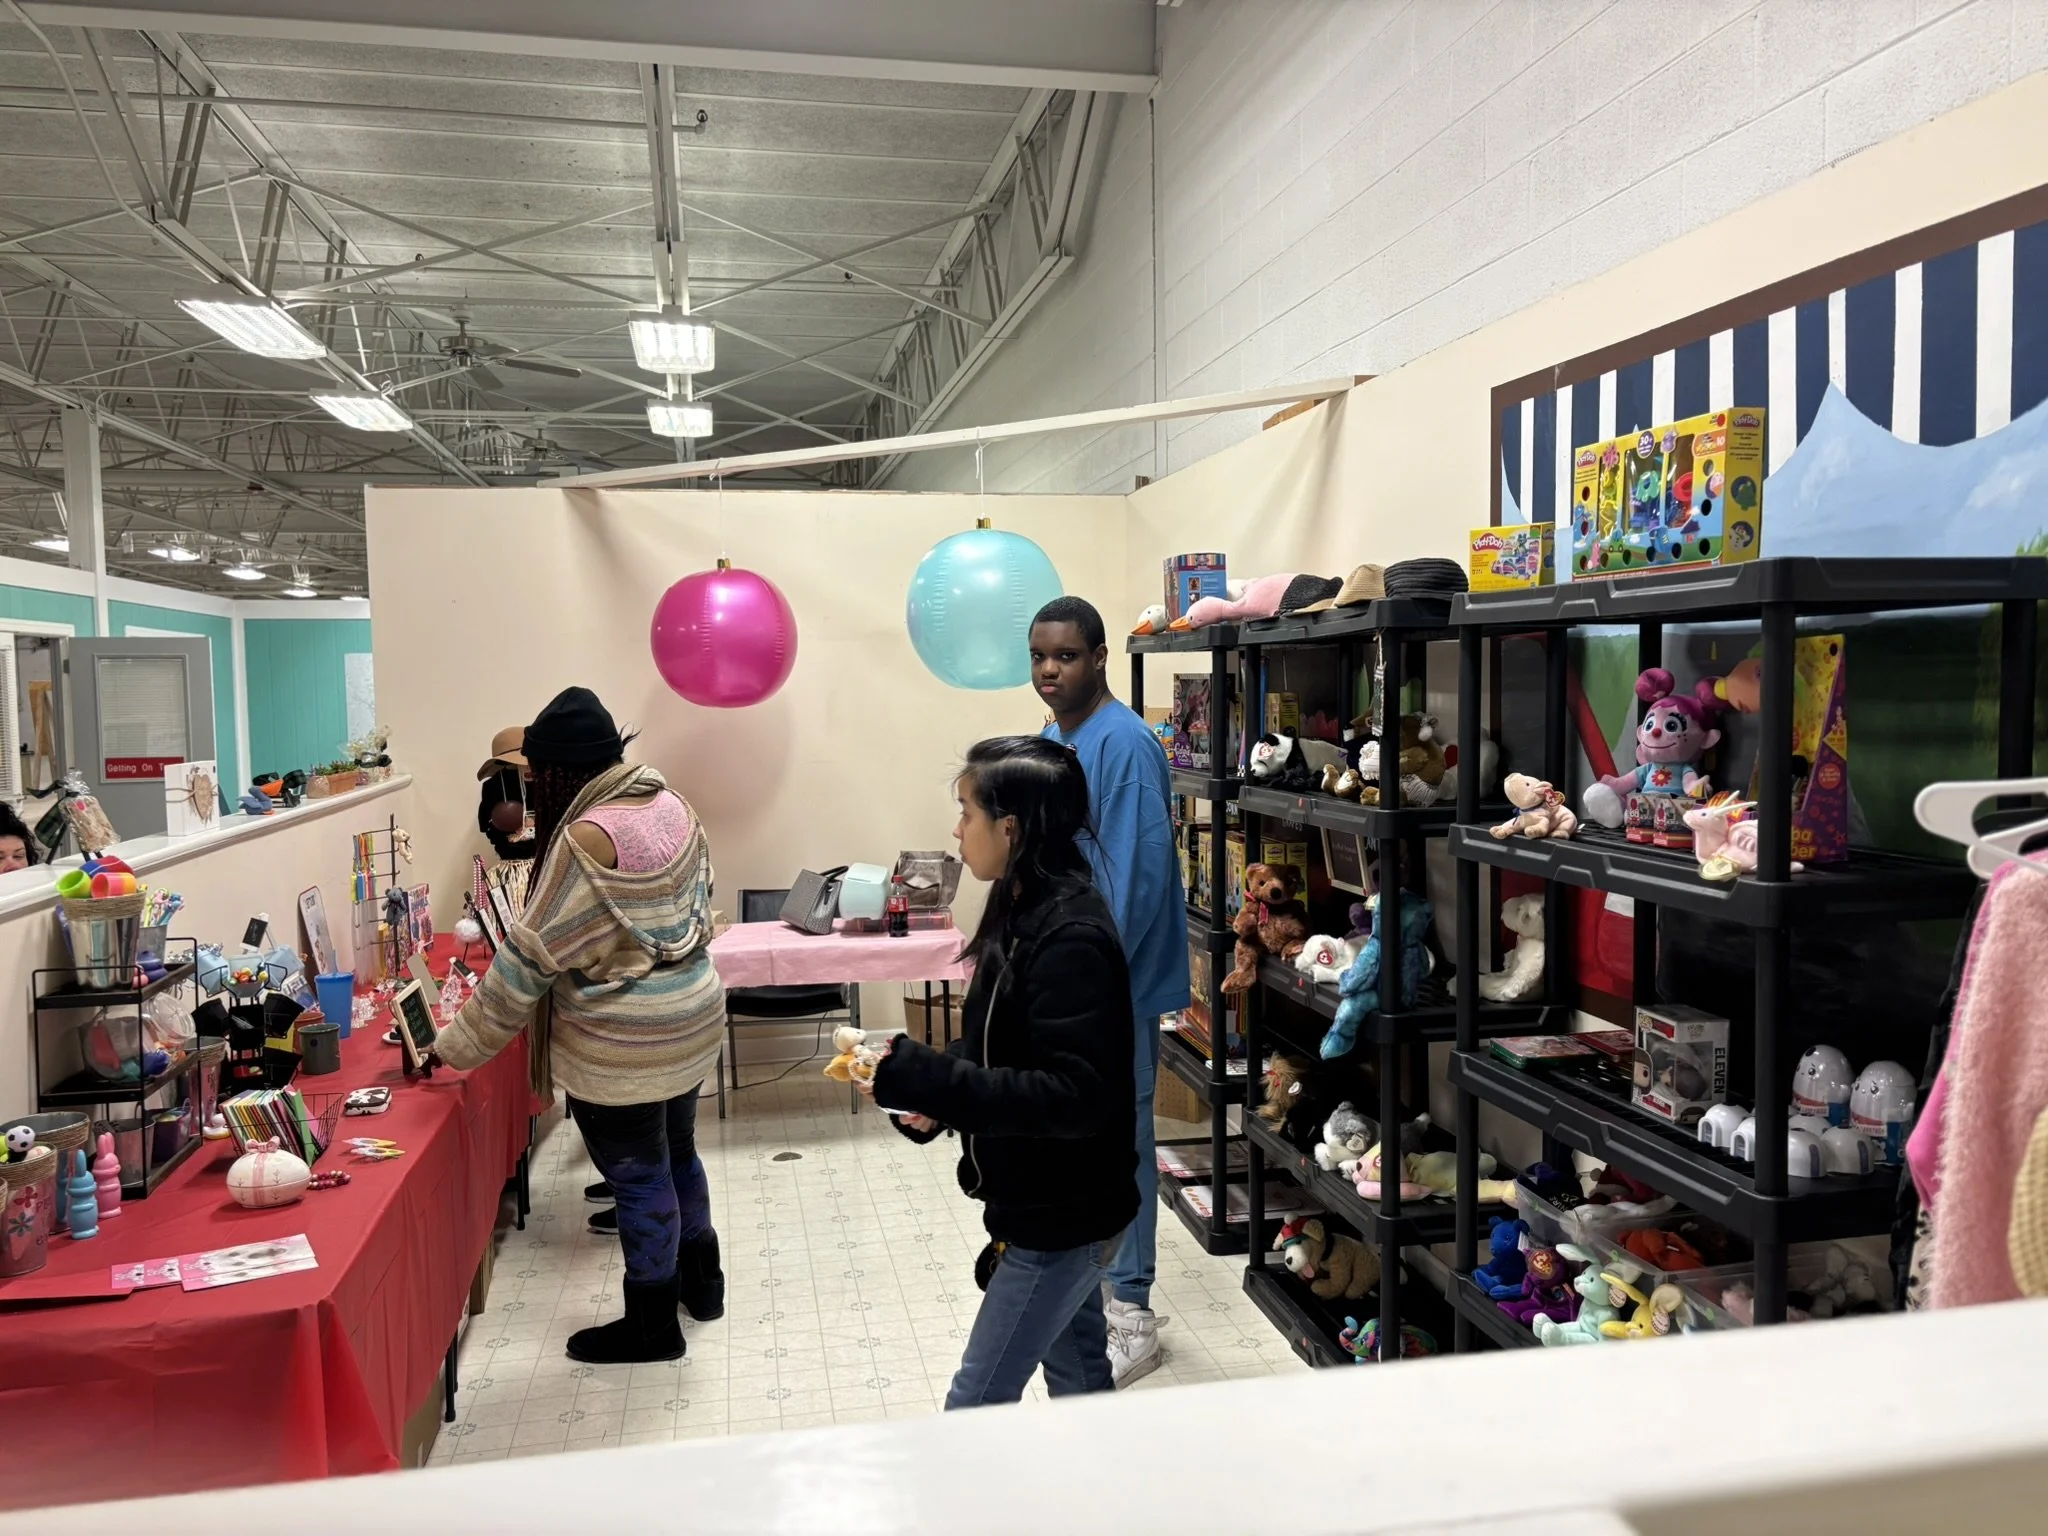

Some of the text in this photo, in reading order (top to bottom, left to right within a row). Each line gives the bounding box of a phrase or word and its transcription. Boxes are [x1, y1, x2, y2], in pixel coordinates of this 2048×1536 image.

[1639, 435, 1653, 446] 30+
[1473, 535, 1504, 550] Play-Doh
[107, 763, 137, 774] Getting
[141, 763, 153, 772] On
[1714, 1047, 1726, 1094] ELEVEN
